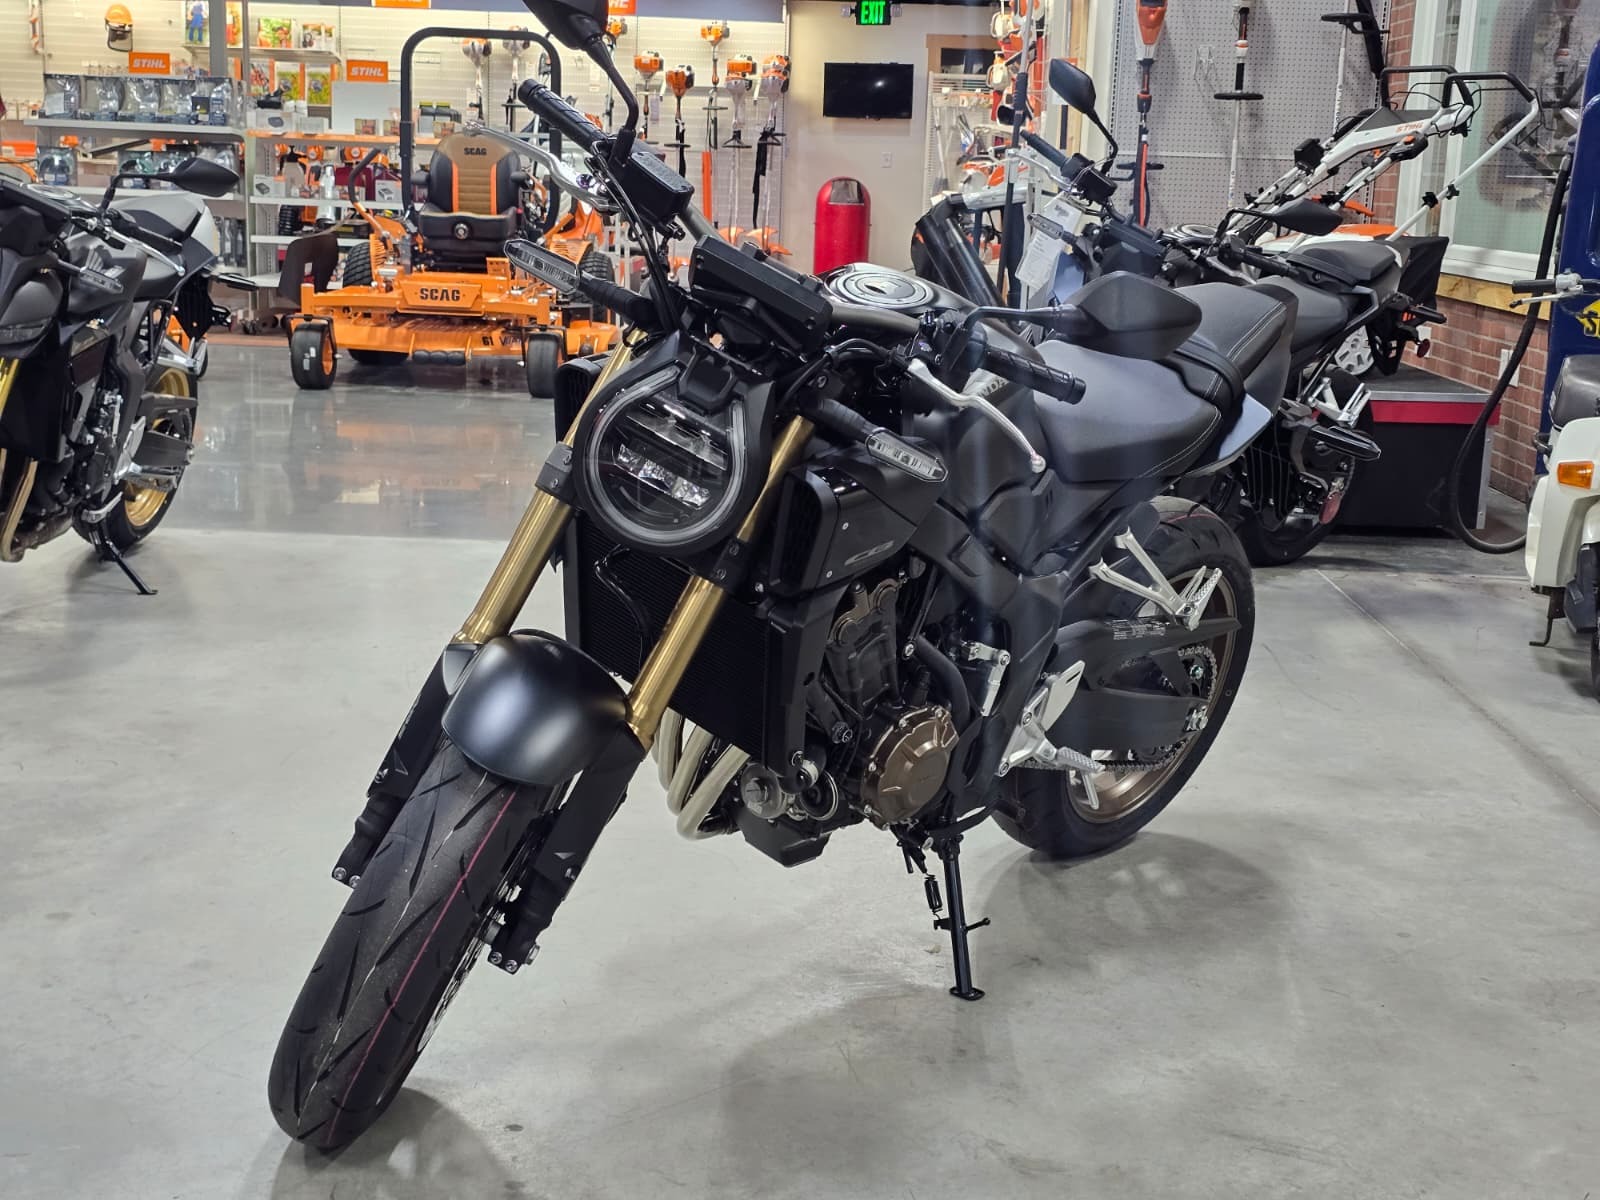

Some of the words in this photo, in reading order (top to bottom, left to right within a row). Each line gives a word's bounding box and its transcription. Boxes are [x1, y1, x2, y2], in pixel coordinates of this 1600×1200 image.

[861, 1, 886, 24] EXIT
[133, 58, 167, 69] STIHL
[351, 66, 385, 77] STIHL
[463, 147, 488, 156] SCAG
[419, 287, 461, 302] SCAG
